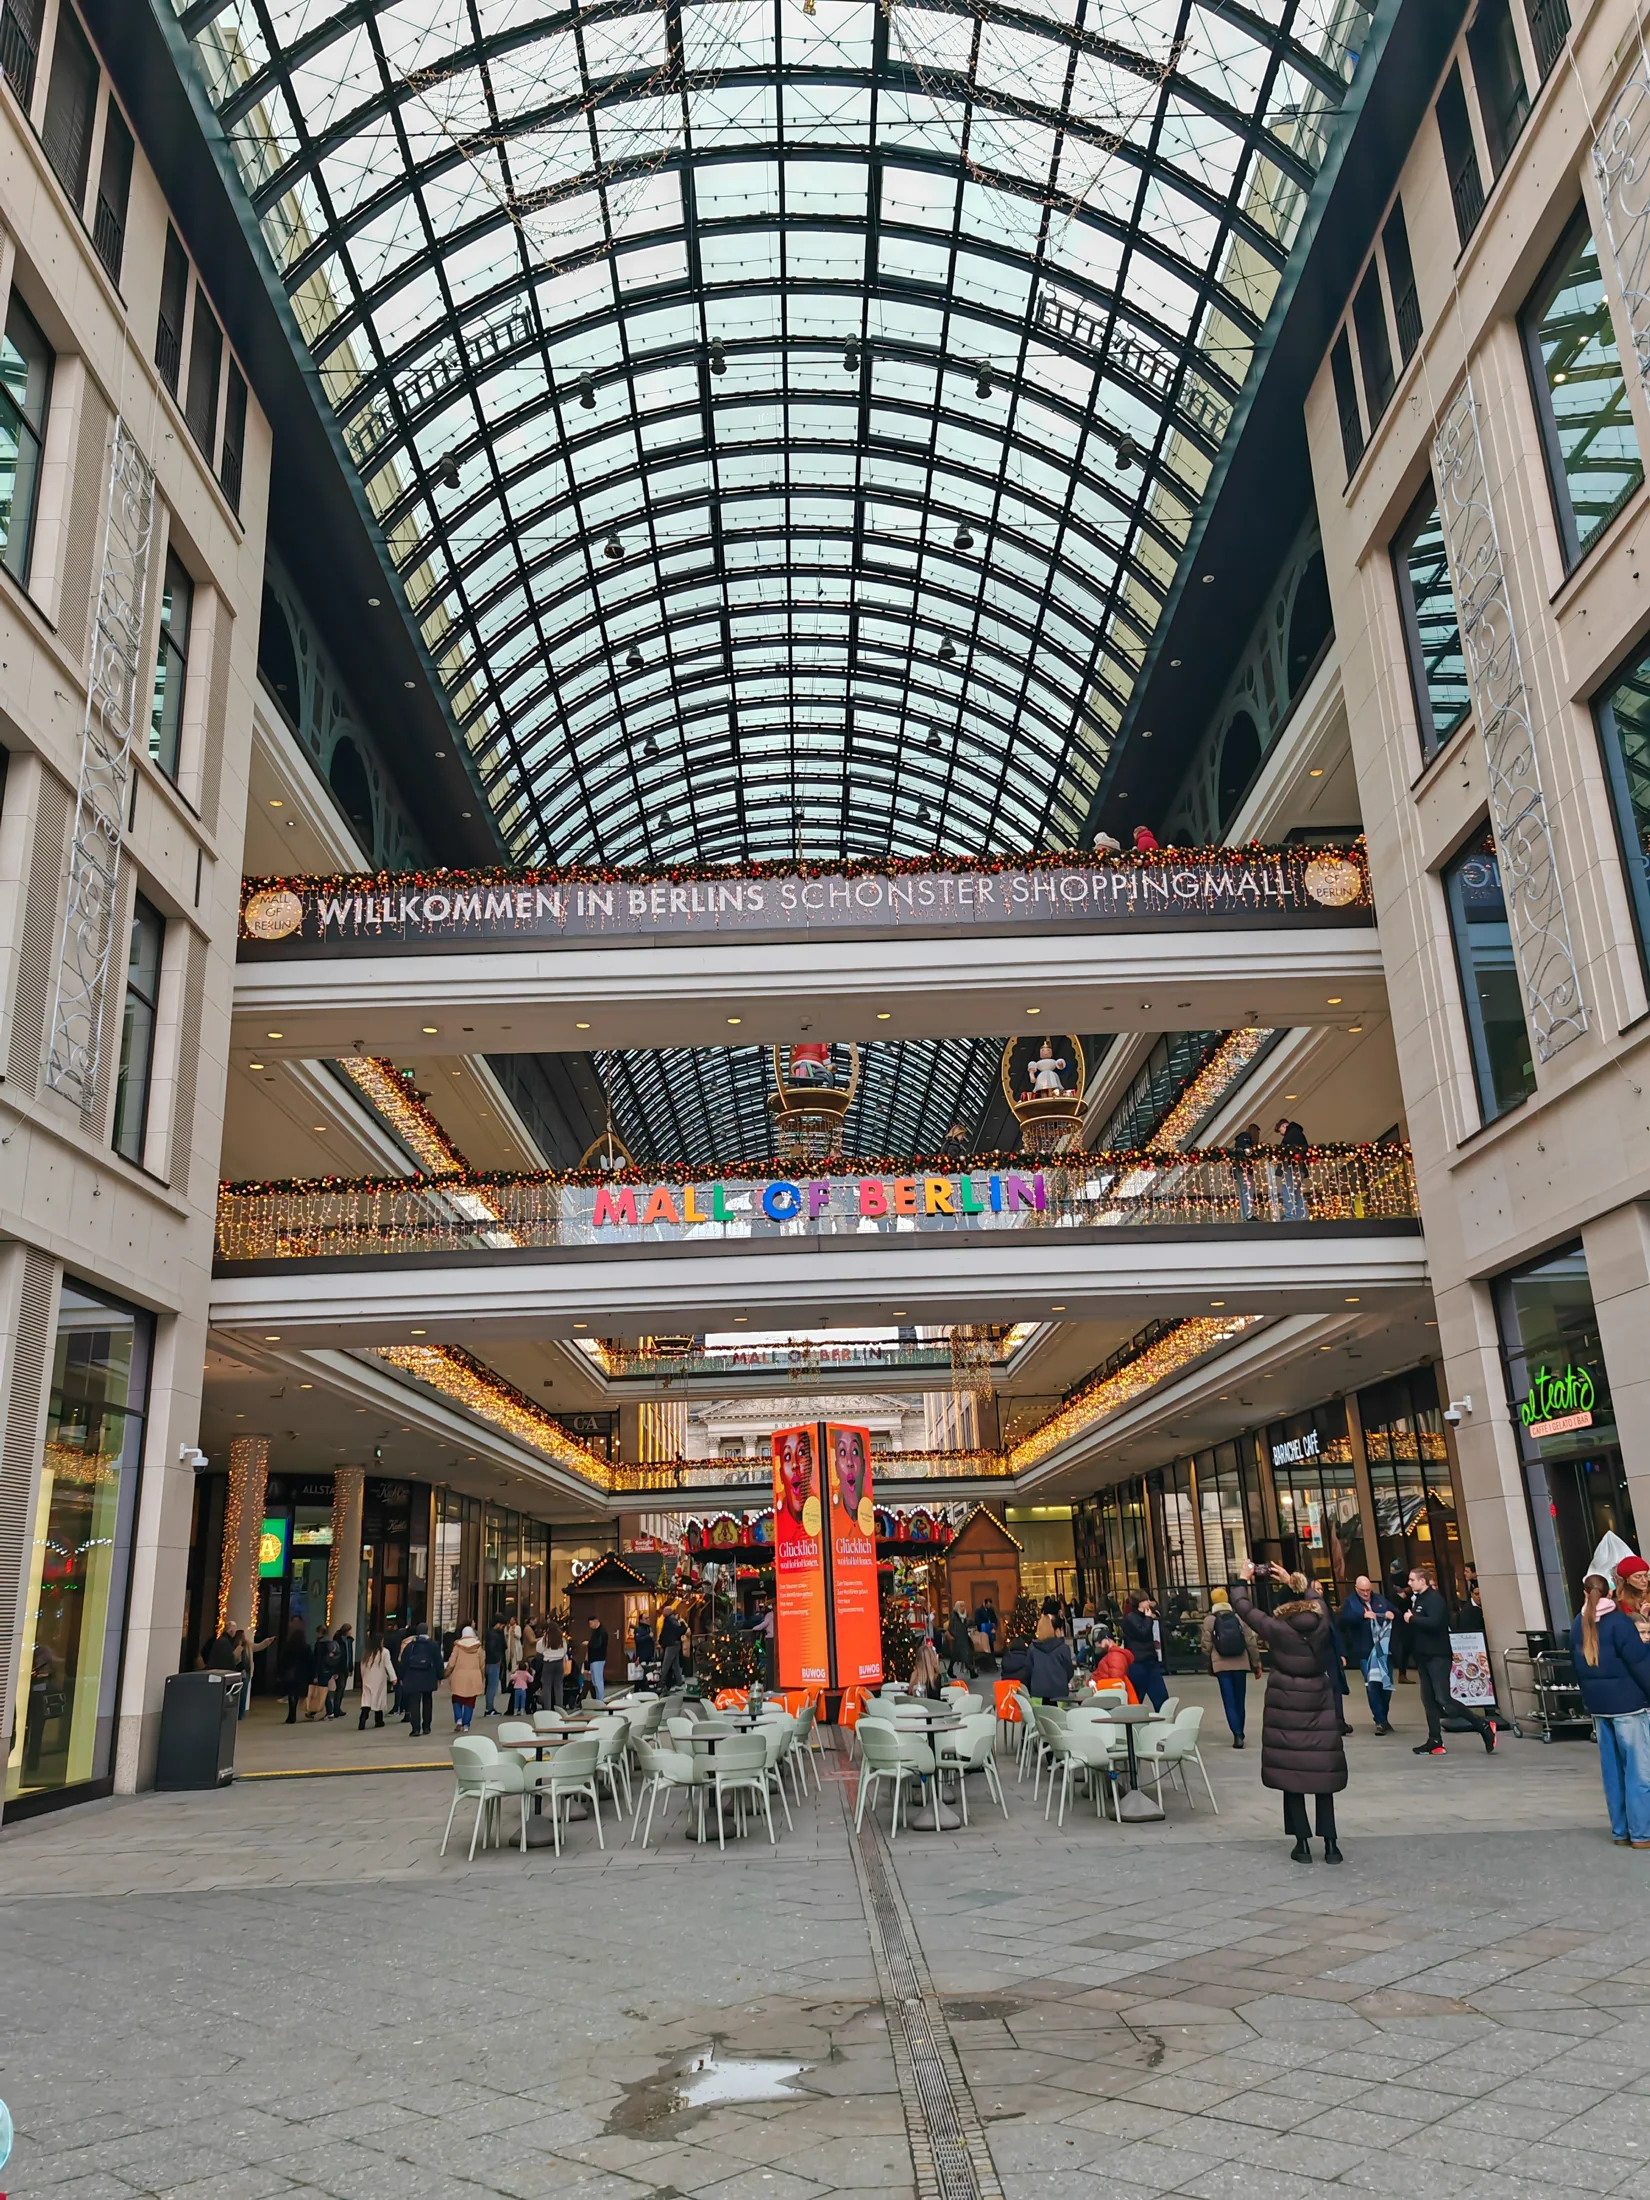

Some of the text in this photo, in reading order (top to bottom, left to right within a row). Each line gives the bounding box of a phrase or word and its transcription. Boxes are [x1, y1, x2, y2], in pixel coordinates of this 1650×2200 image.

[260, 894, 290, 904] MALL
[317, 891, 560, 925] WILLKOMMEN
[577, 889, 613, 917] IN
[630, 885, 764, 915] BERLINS
[1012, 869, 1292, 903] SHOPPINGMALL
[1316, 887, 1353, 898] BERLIN
[265, 907, 283, 917] OF
[254, 920, 291, 931] BERLIN
[593, 1174, 1046, 1227] MALL OF BERLIN
[732, 1351, 781, 1366] MALL
[820, 1347, 882, 1362] BERLIN
[1521, 1389, 1543, 1427] al
[1551, 1418, 1573, 1432] GELATO
[1577, 1414, 1589, 1426] BAR
[1303, 1429, 1320, 1457] CAFÉ
[779, 1539, 818, 1558] Glücklich
[835, 1537, 872, 1554] Glücklich
[802, 1668, 826, 1678] BUWOG
[858, 1664, 880, 1675] BUWOG
